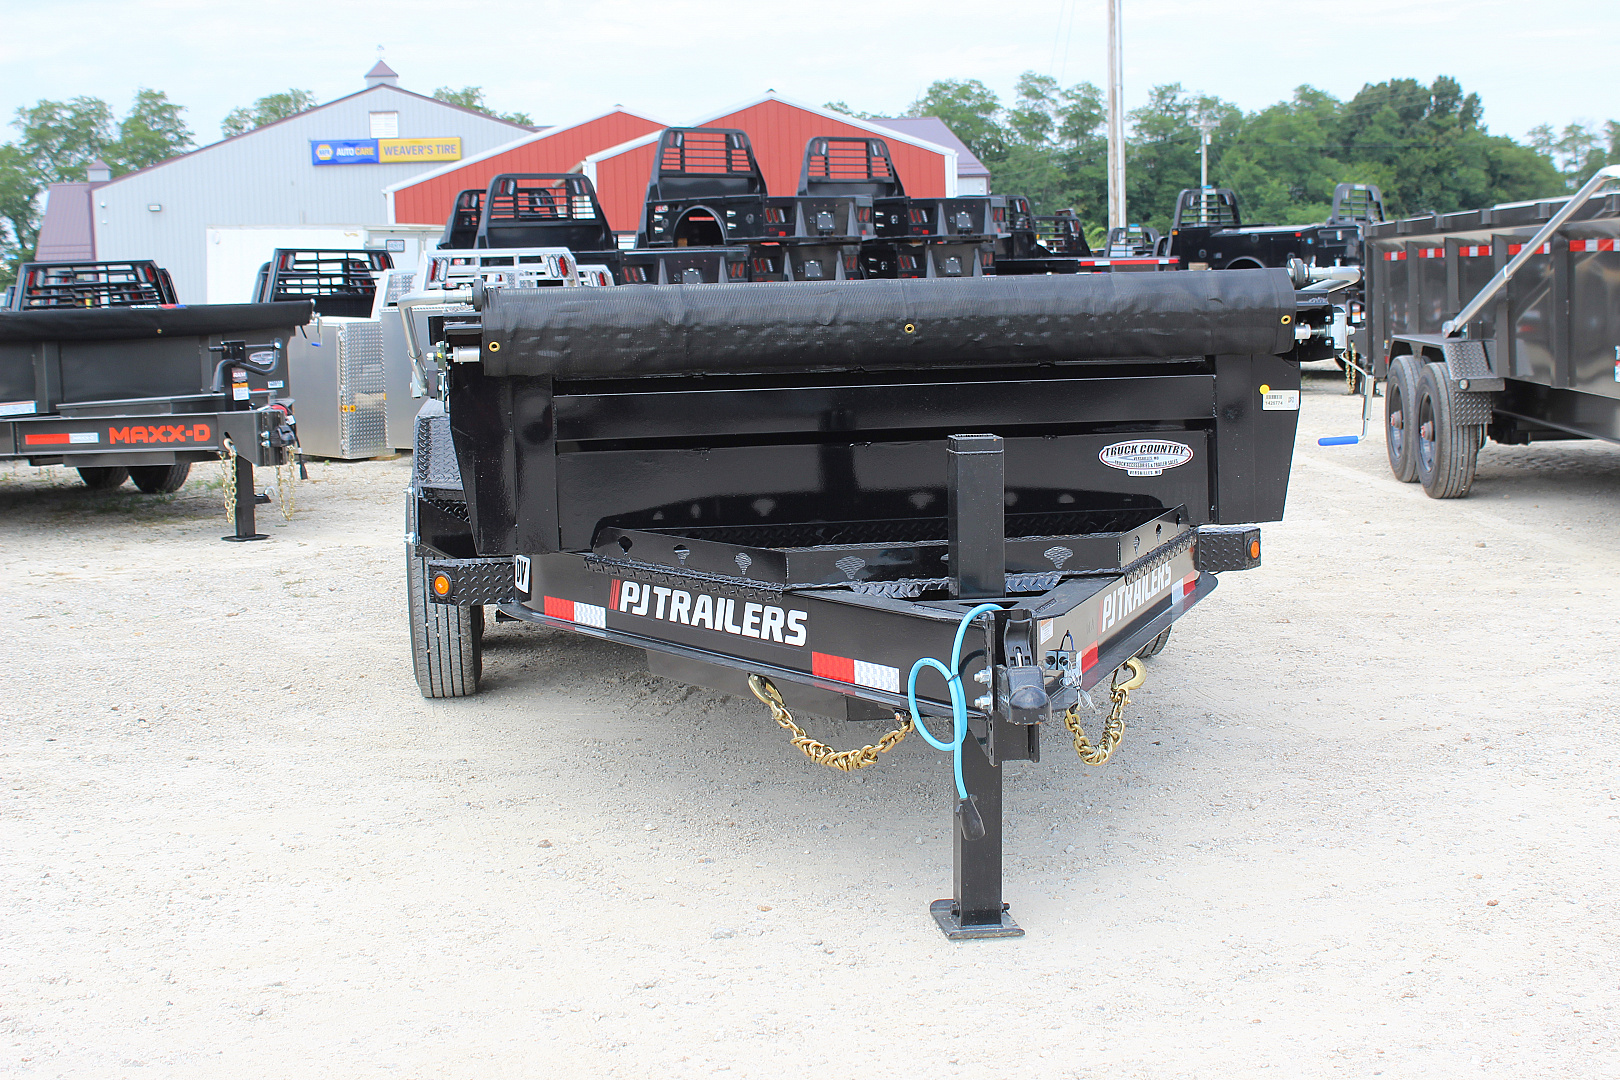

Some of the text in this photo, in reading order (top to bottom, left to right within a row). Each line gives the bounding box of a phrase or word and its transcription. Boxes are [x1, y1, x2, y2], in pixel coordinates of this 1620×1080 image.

[336, 147, 354, 156] AUTO
[355, 147, 374, 155] CARE
[383, 144, 457, 155] WEAVER'S TIRE
[109, 424, 211, 444] MAXX-D
[1105, 444, 1186, 457] TRUCK COUNTRY
[1101, 562, 1172, 633] PJ TRAILERS
[619, 580, 808, 647] PJ TRAILERS
